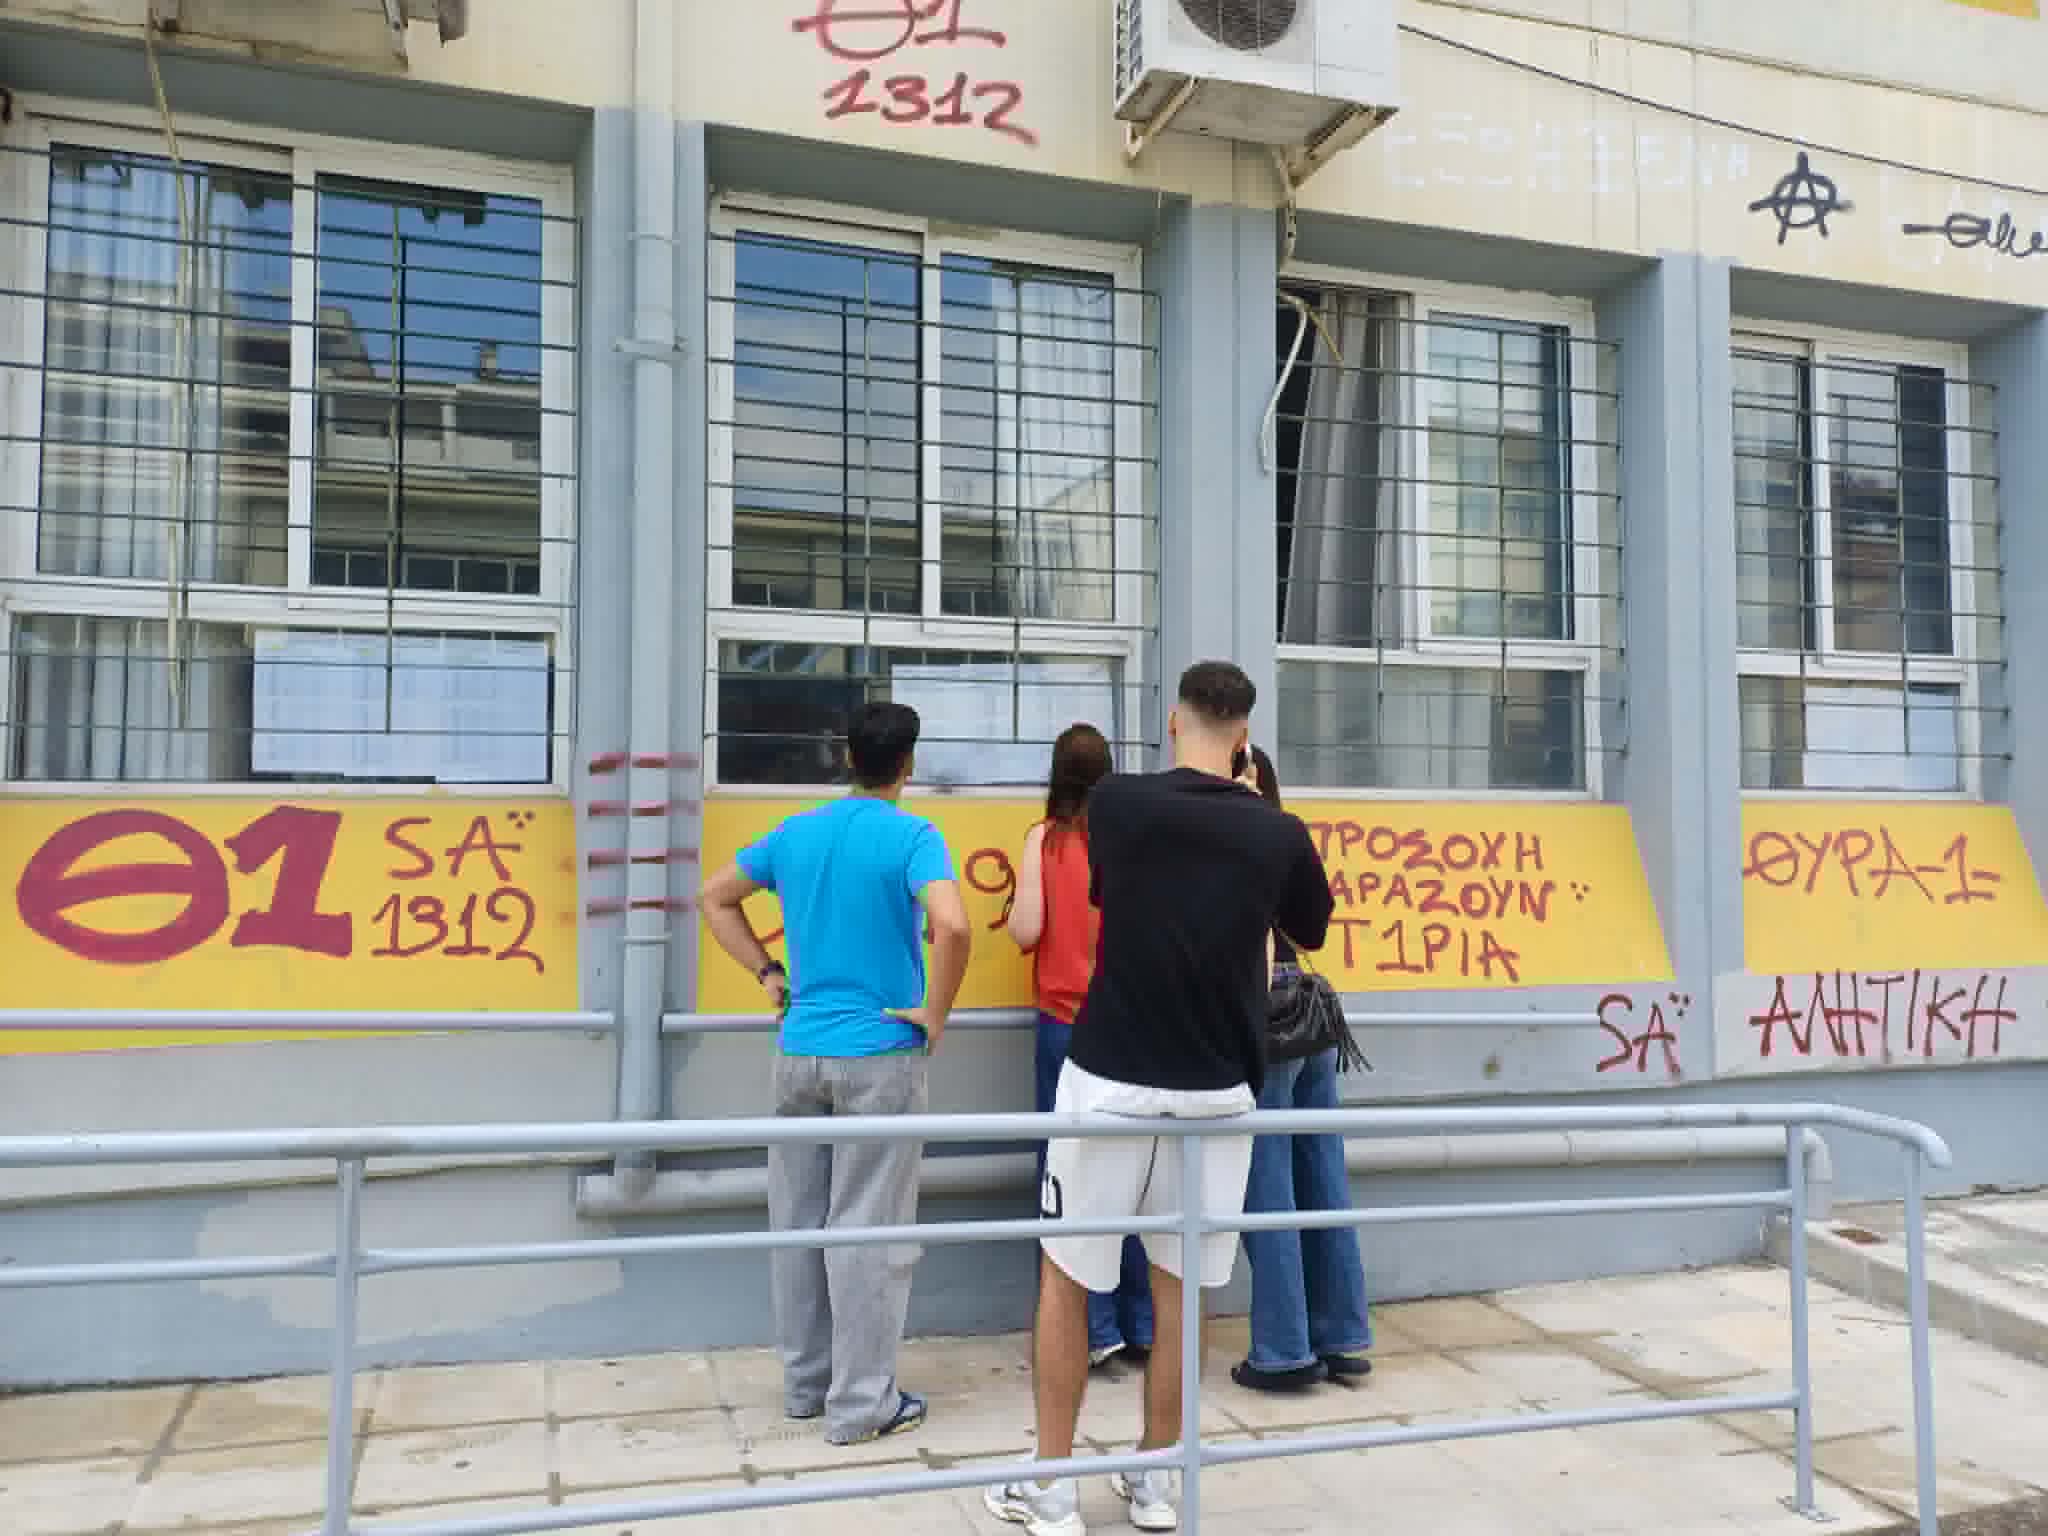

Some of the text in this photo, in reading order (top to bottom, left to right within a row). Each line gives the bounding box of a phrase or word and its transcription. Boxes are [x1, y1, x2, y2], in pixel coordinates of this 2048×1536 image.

[822, 68, 1039, 146] 1312
[370, 885, 546, 974] 1312
[1327, 869, 1556, 923] ΑΡΑΖΟΥΝ
